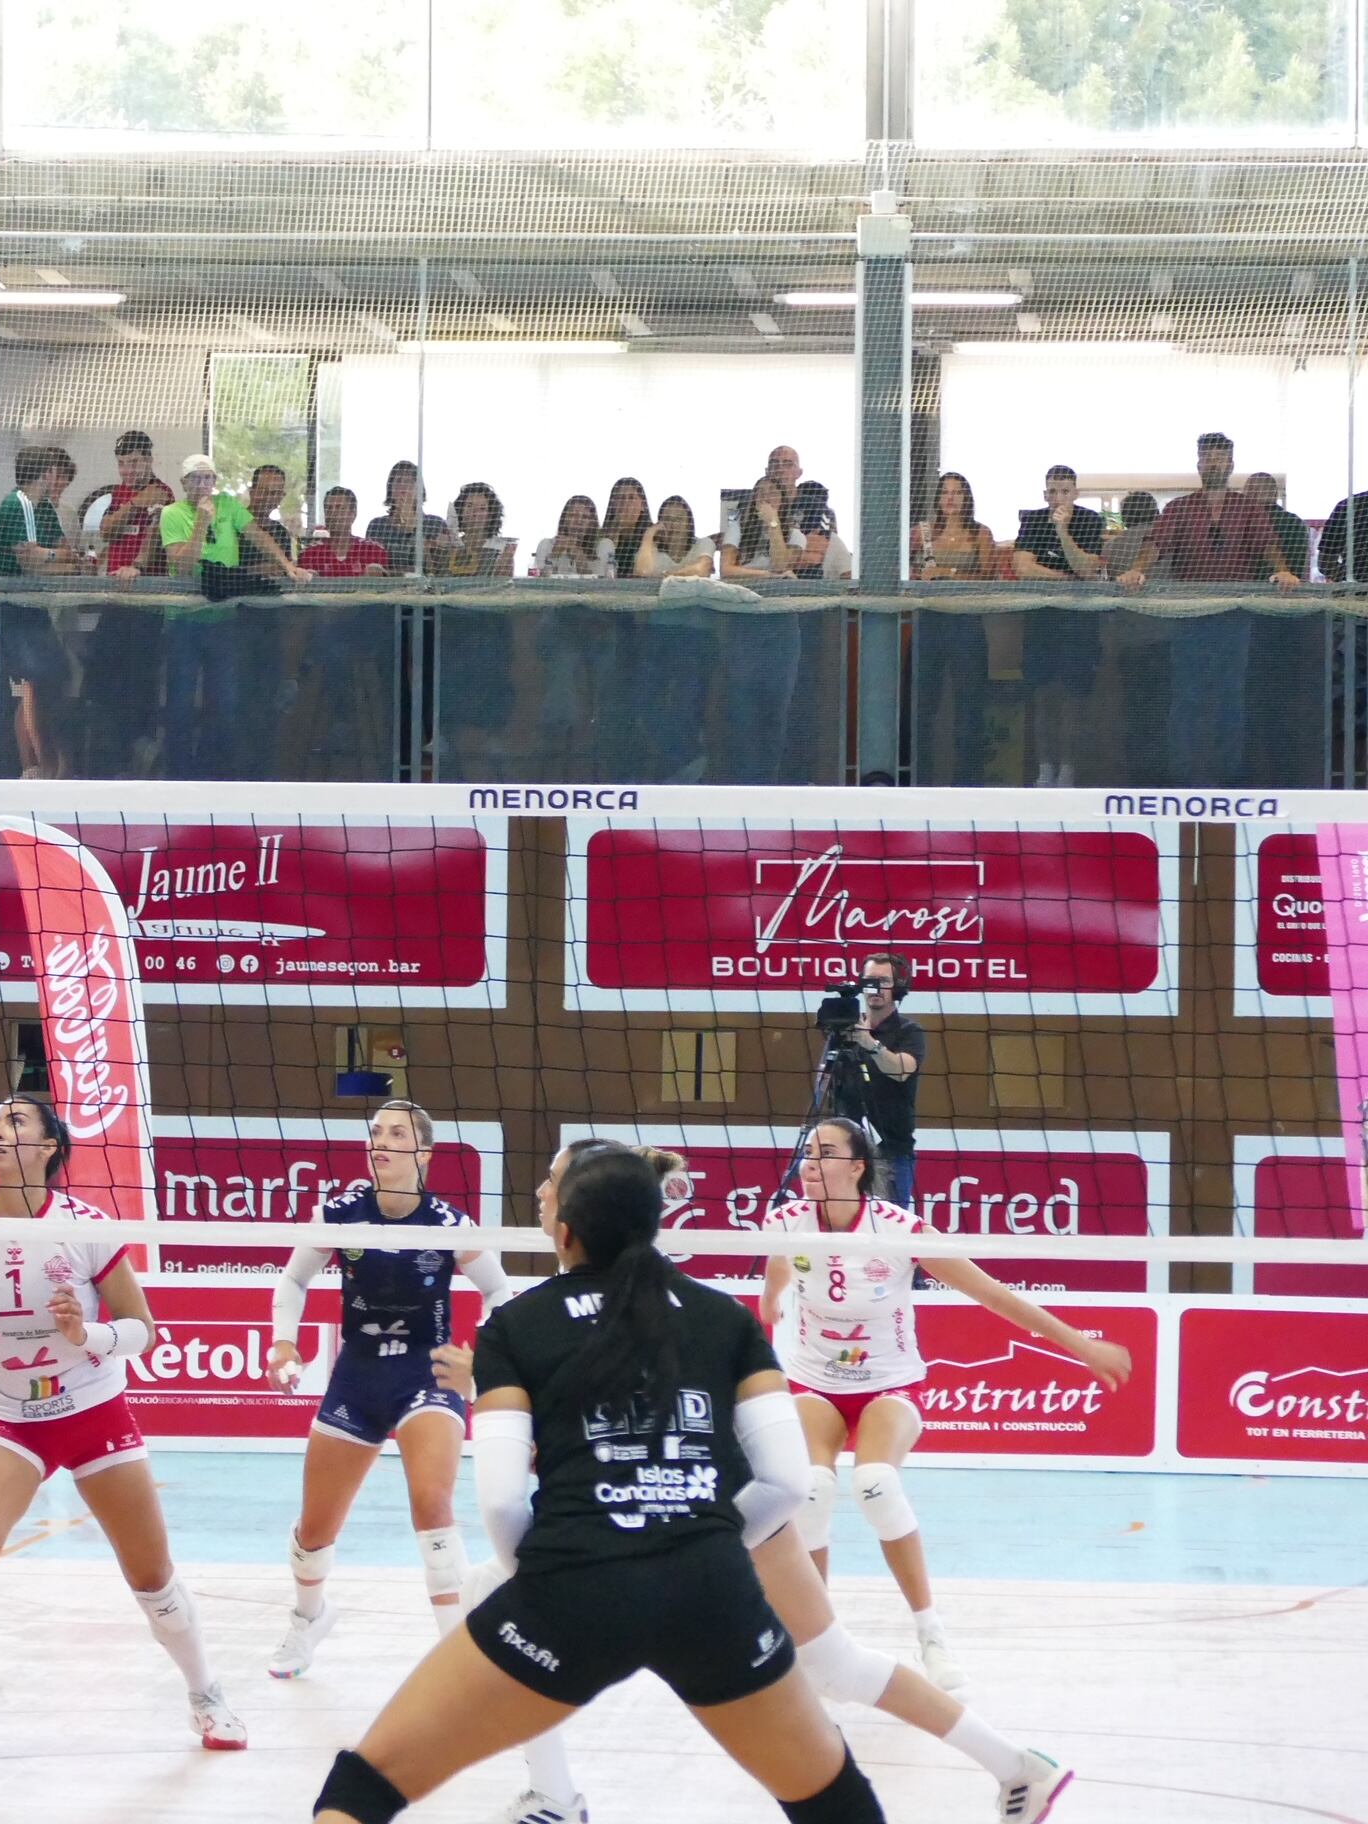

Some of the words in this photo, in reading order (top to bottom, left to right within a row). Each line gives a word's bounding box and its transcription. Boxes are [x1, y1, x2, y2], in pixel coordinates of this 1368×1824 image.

[469, 789, 639, 810] MENORCA
[1105, 795, 1278, 816] MENORCA
[127, 846, 247, 919] Jaume
[755, 844, 981, 954] Marosi
[144, 956, 165, 969] 00
[175, 956, 197, 969] 46
[275, 958, 422, 976] jaumesegon.bar
[911, 958, 1028, 978] HOTEL
[4, 1268, 23, 1309] 1
[828, 1269, 847, 1303] 8
[1229, 1371, 1368, 1423] Const
[921, 1421, 991, 1431] FERRETERIA
[1002, 1420, 1087, 1432] CONSTRUCCIÓ
[1245, 1427, 1270, 1437] TOT
[1272, 1427, 1290, 1438] EN
[1292, 1428, 1366, 1440] FERRETERIA
[636, 1464, 685, 1485] Islas
[594, 1482, 687, 1503] Canarias
